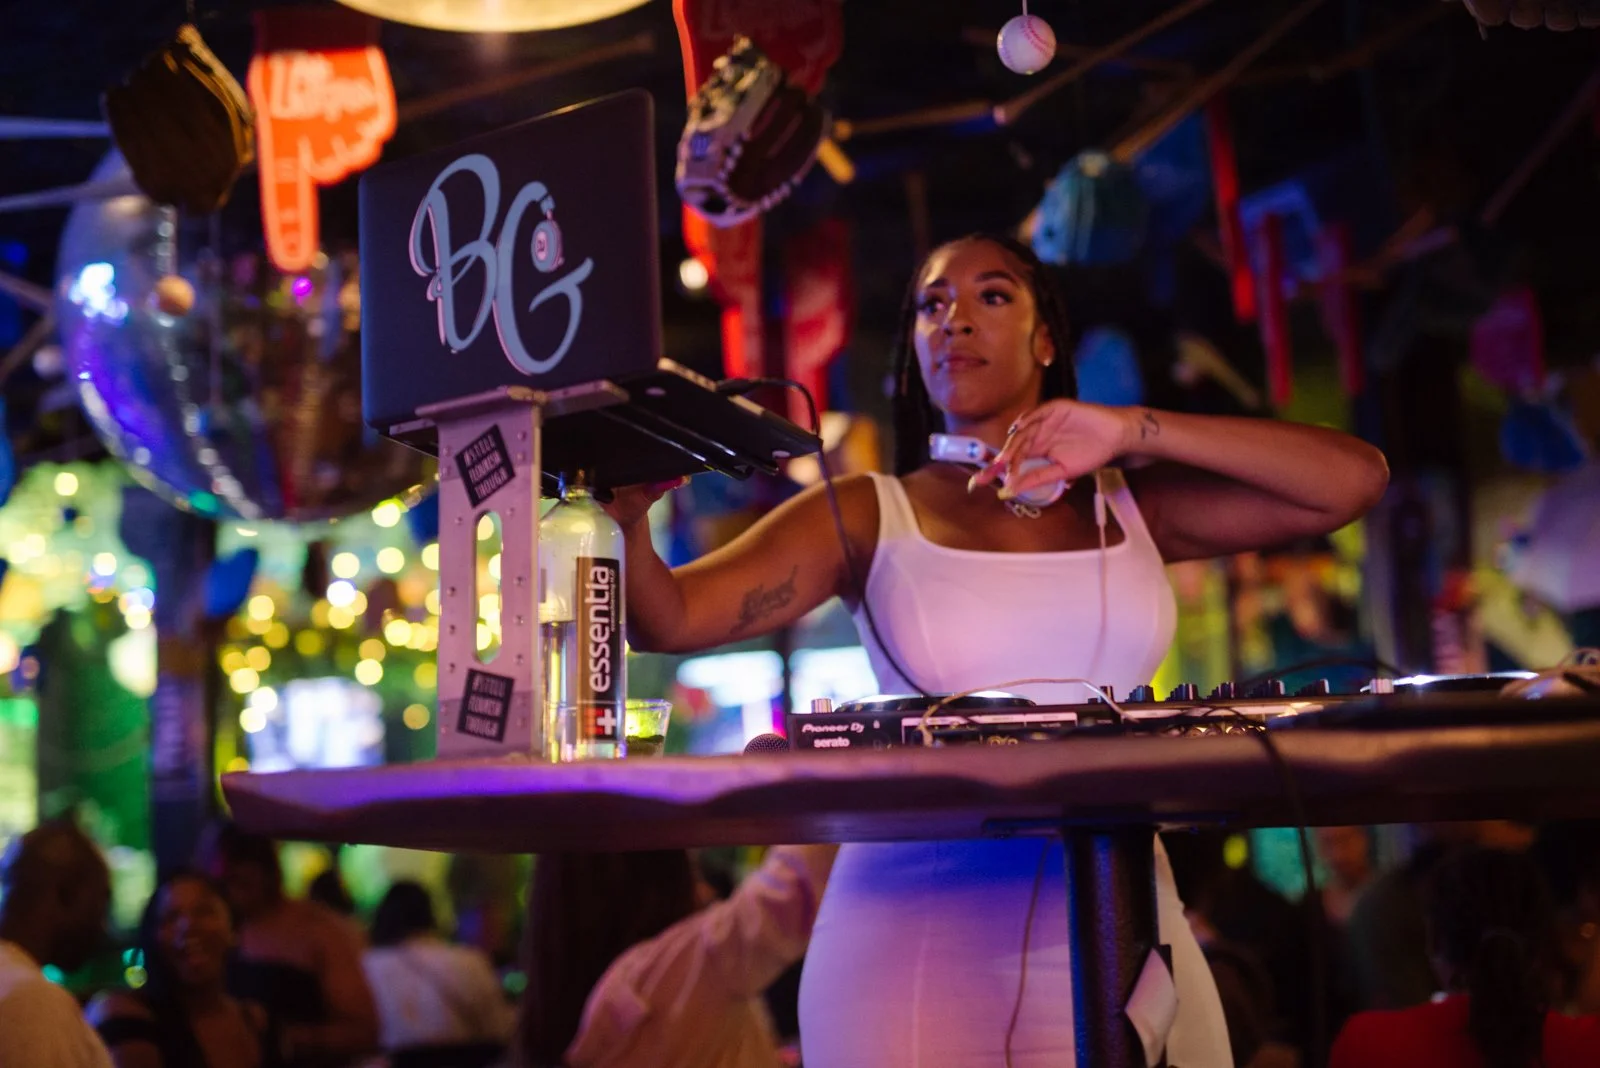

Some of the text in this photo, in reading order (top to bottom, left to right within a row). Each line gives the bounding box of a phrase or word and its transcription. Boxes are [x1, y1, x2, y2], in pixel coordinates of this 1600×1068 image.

[408, 153, 594, 375] BG
[585, 565, 611, 692] essentia
[801, 723, 849, 734] Pioneer
[813, 736, 851, 749] serato
